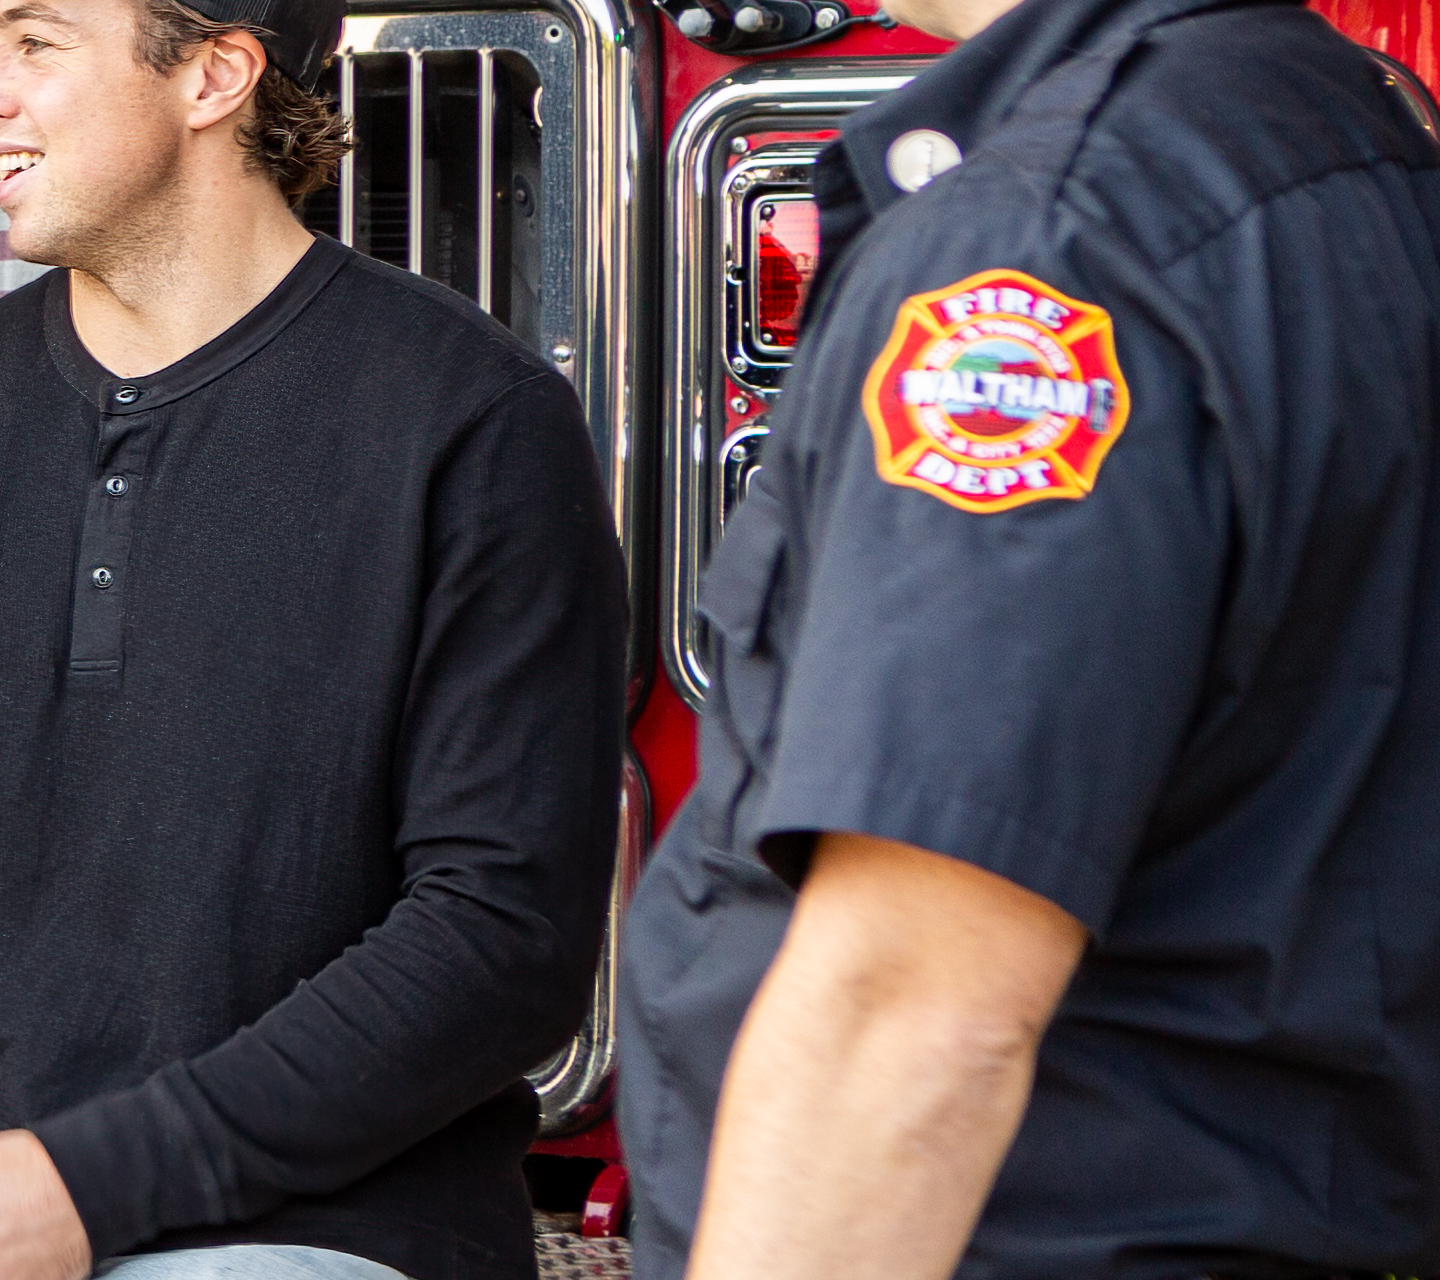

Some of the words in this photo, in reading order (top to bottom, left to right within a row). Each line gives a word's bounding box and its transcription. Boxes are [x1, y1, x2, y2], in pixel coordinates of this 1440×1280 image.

[941, 287, 1070, 331] FIRE
[901, 369, 1089, 418] WALTHAM
[912, 451, 1051, 496] DEPT
